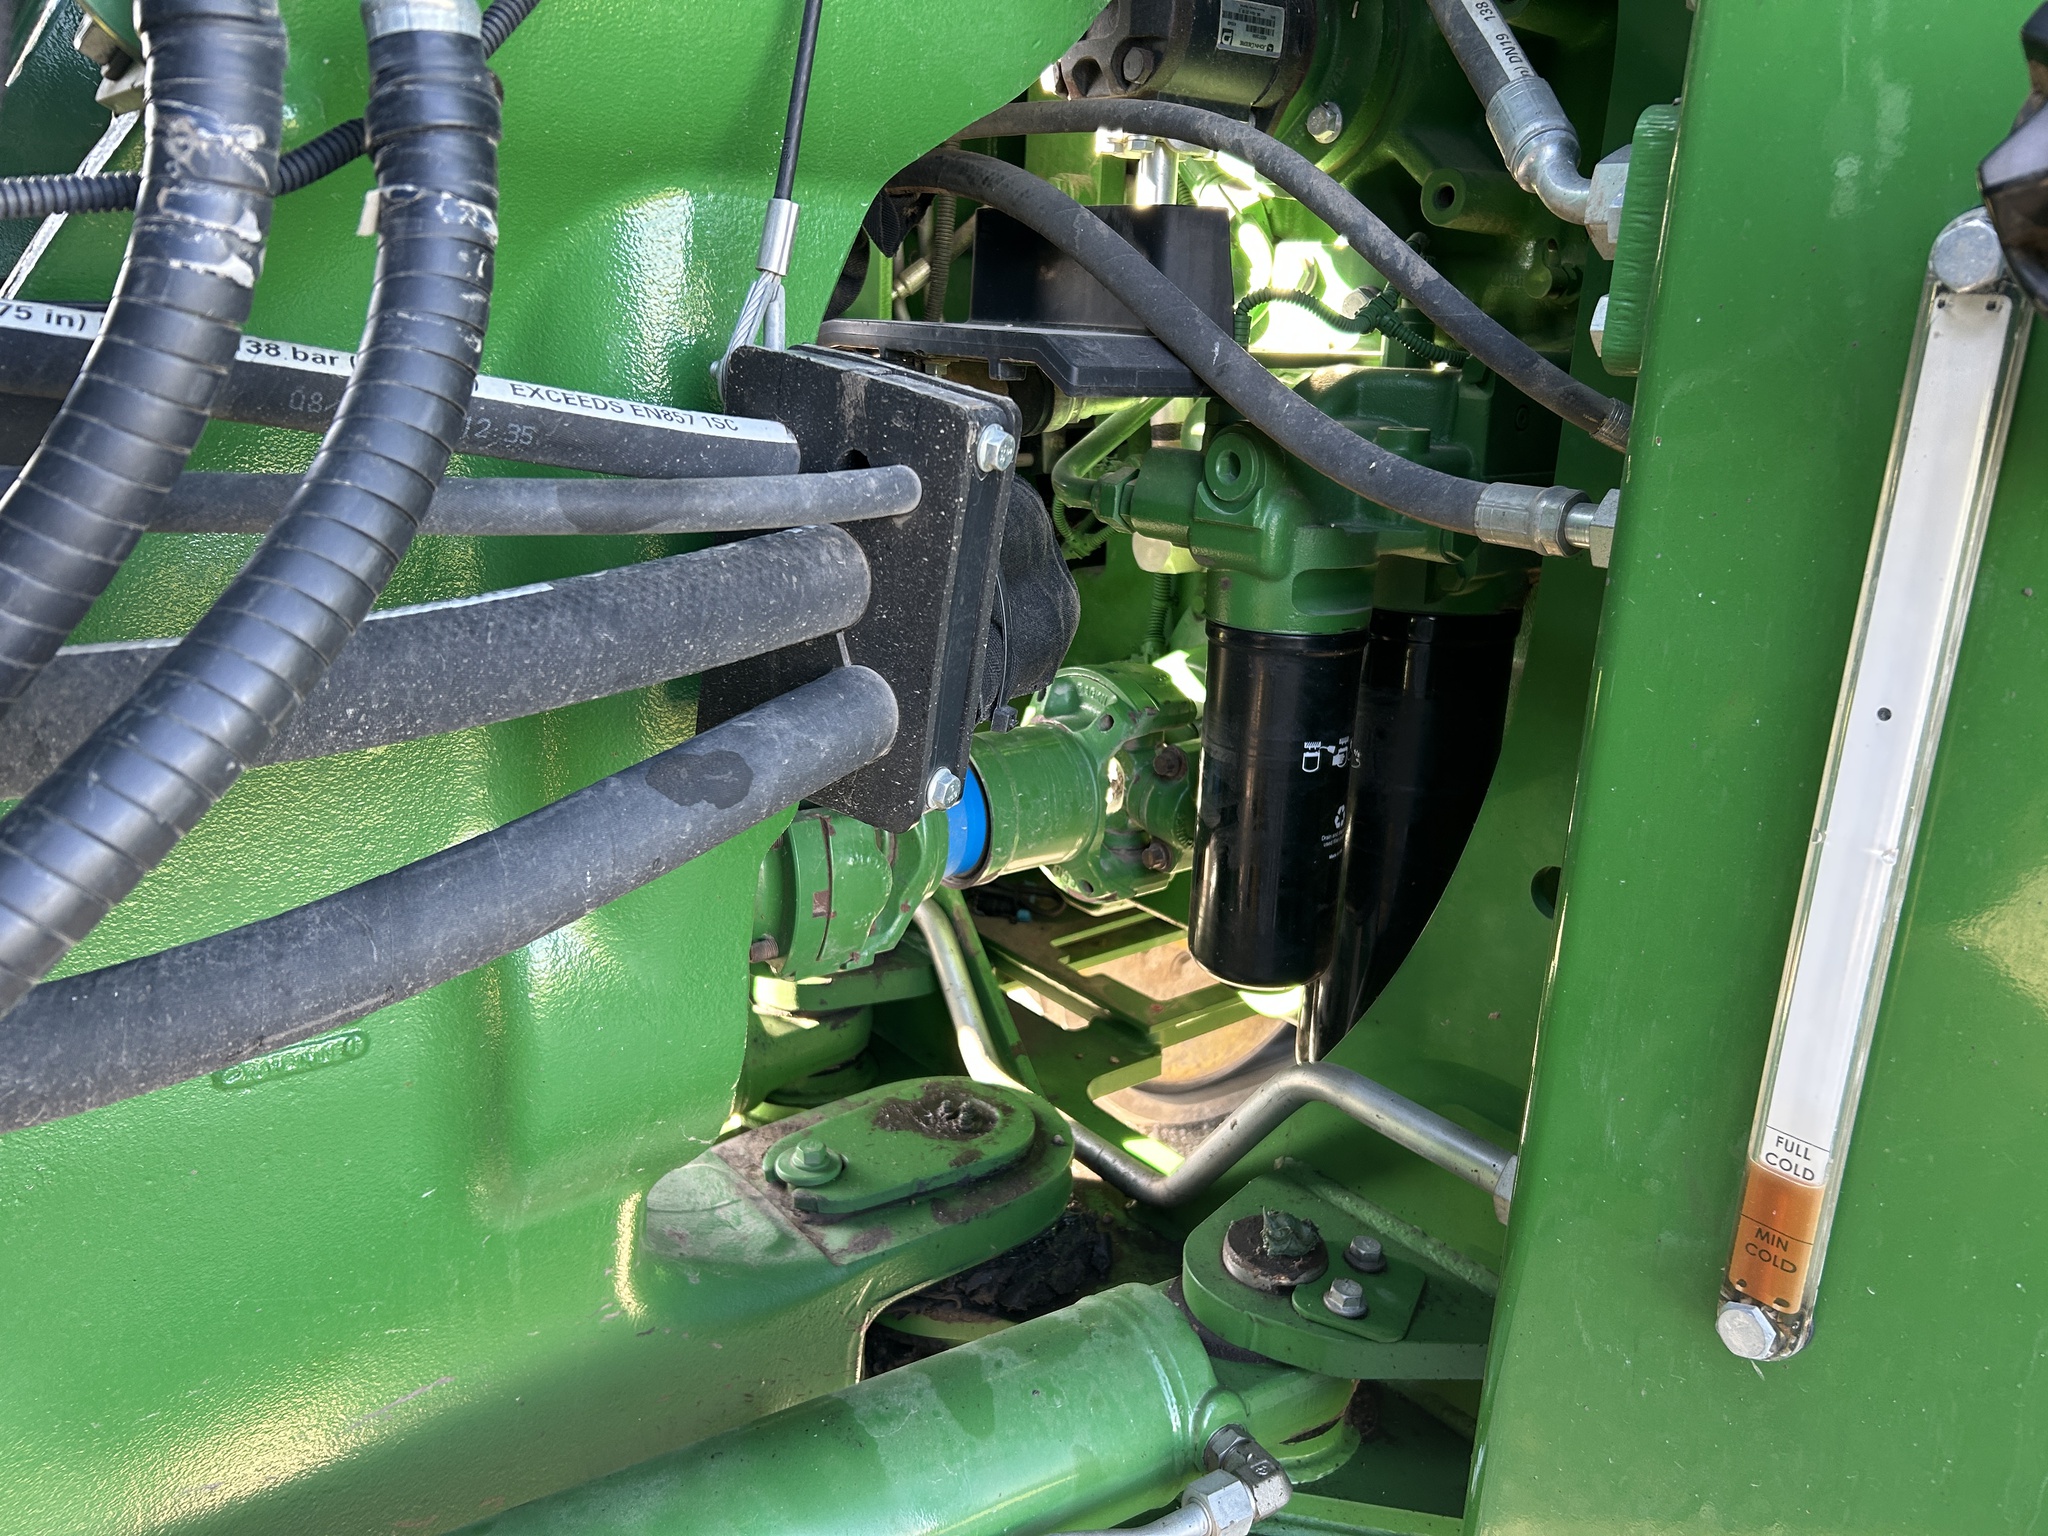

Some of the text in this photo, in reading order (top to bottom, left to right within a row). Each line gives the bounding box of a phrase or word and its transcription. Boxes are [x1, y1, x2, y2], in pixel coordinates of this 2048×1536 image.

[1475, 1, 1496, 22] 138
[1495, 34, 1523, 64] DN19
[45, 308, 86, 331] in)
[291, 346, 340, 366] bar
[509, 382, 739, 432] EXCEEDS EN857 1SC
[1775, 1135, 1811, 1161] FULL
[1765, 1152, 1815, 1181] COLD
[1755, 1227, 1789, 1252] MIN
[1744, 1242, 1797, 1274] COLD
